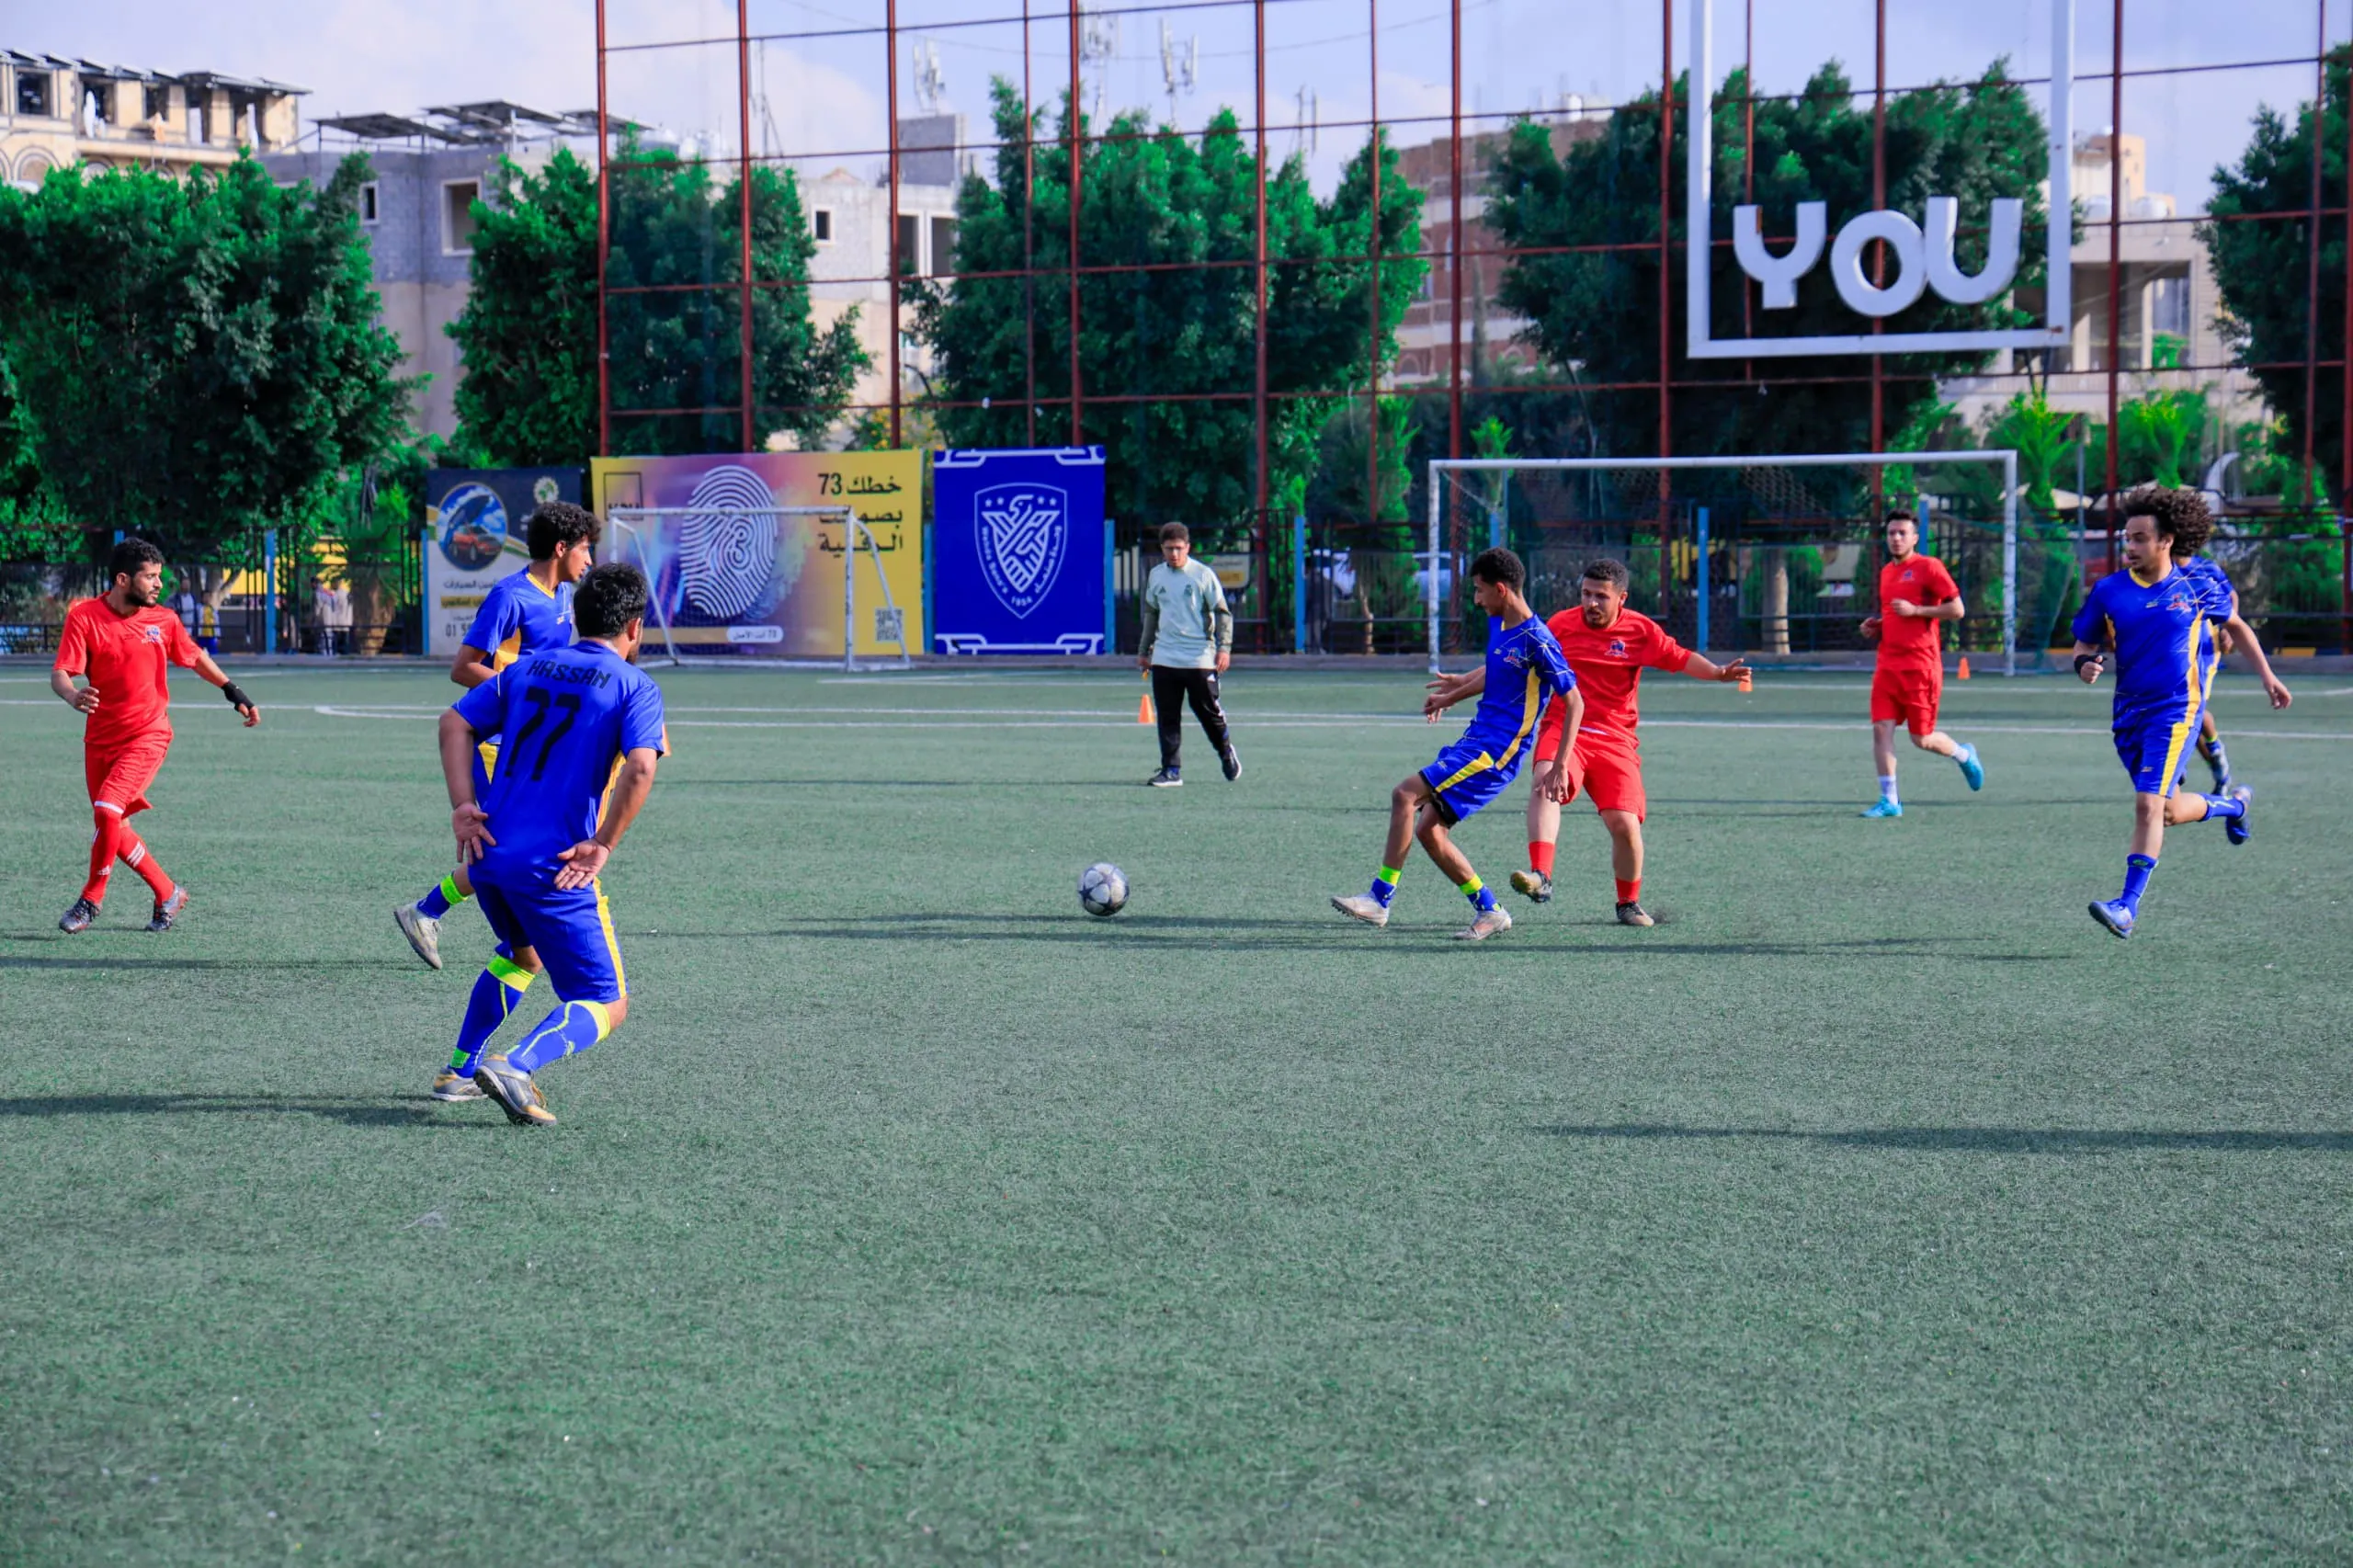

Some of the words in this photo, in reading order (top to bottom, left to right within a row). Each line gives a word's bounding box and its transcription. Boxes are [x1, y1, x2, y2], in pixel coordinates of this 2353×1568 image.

[1733, 196, 2022, 317] YOU
[817, 472, 842, 494] 73
[847, 474, 903, 494] خطك
[504, 686, 581, 781] 77
